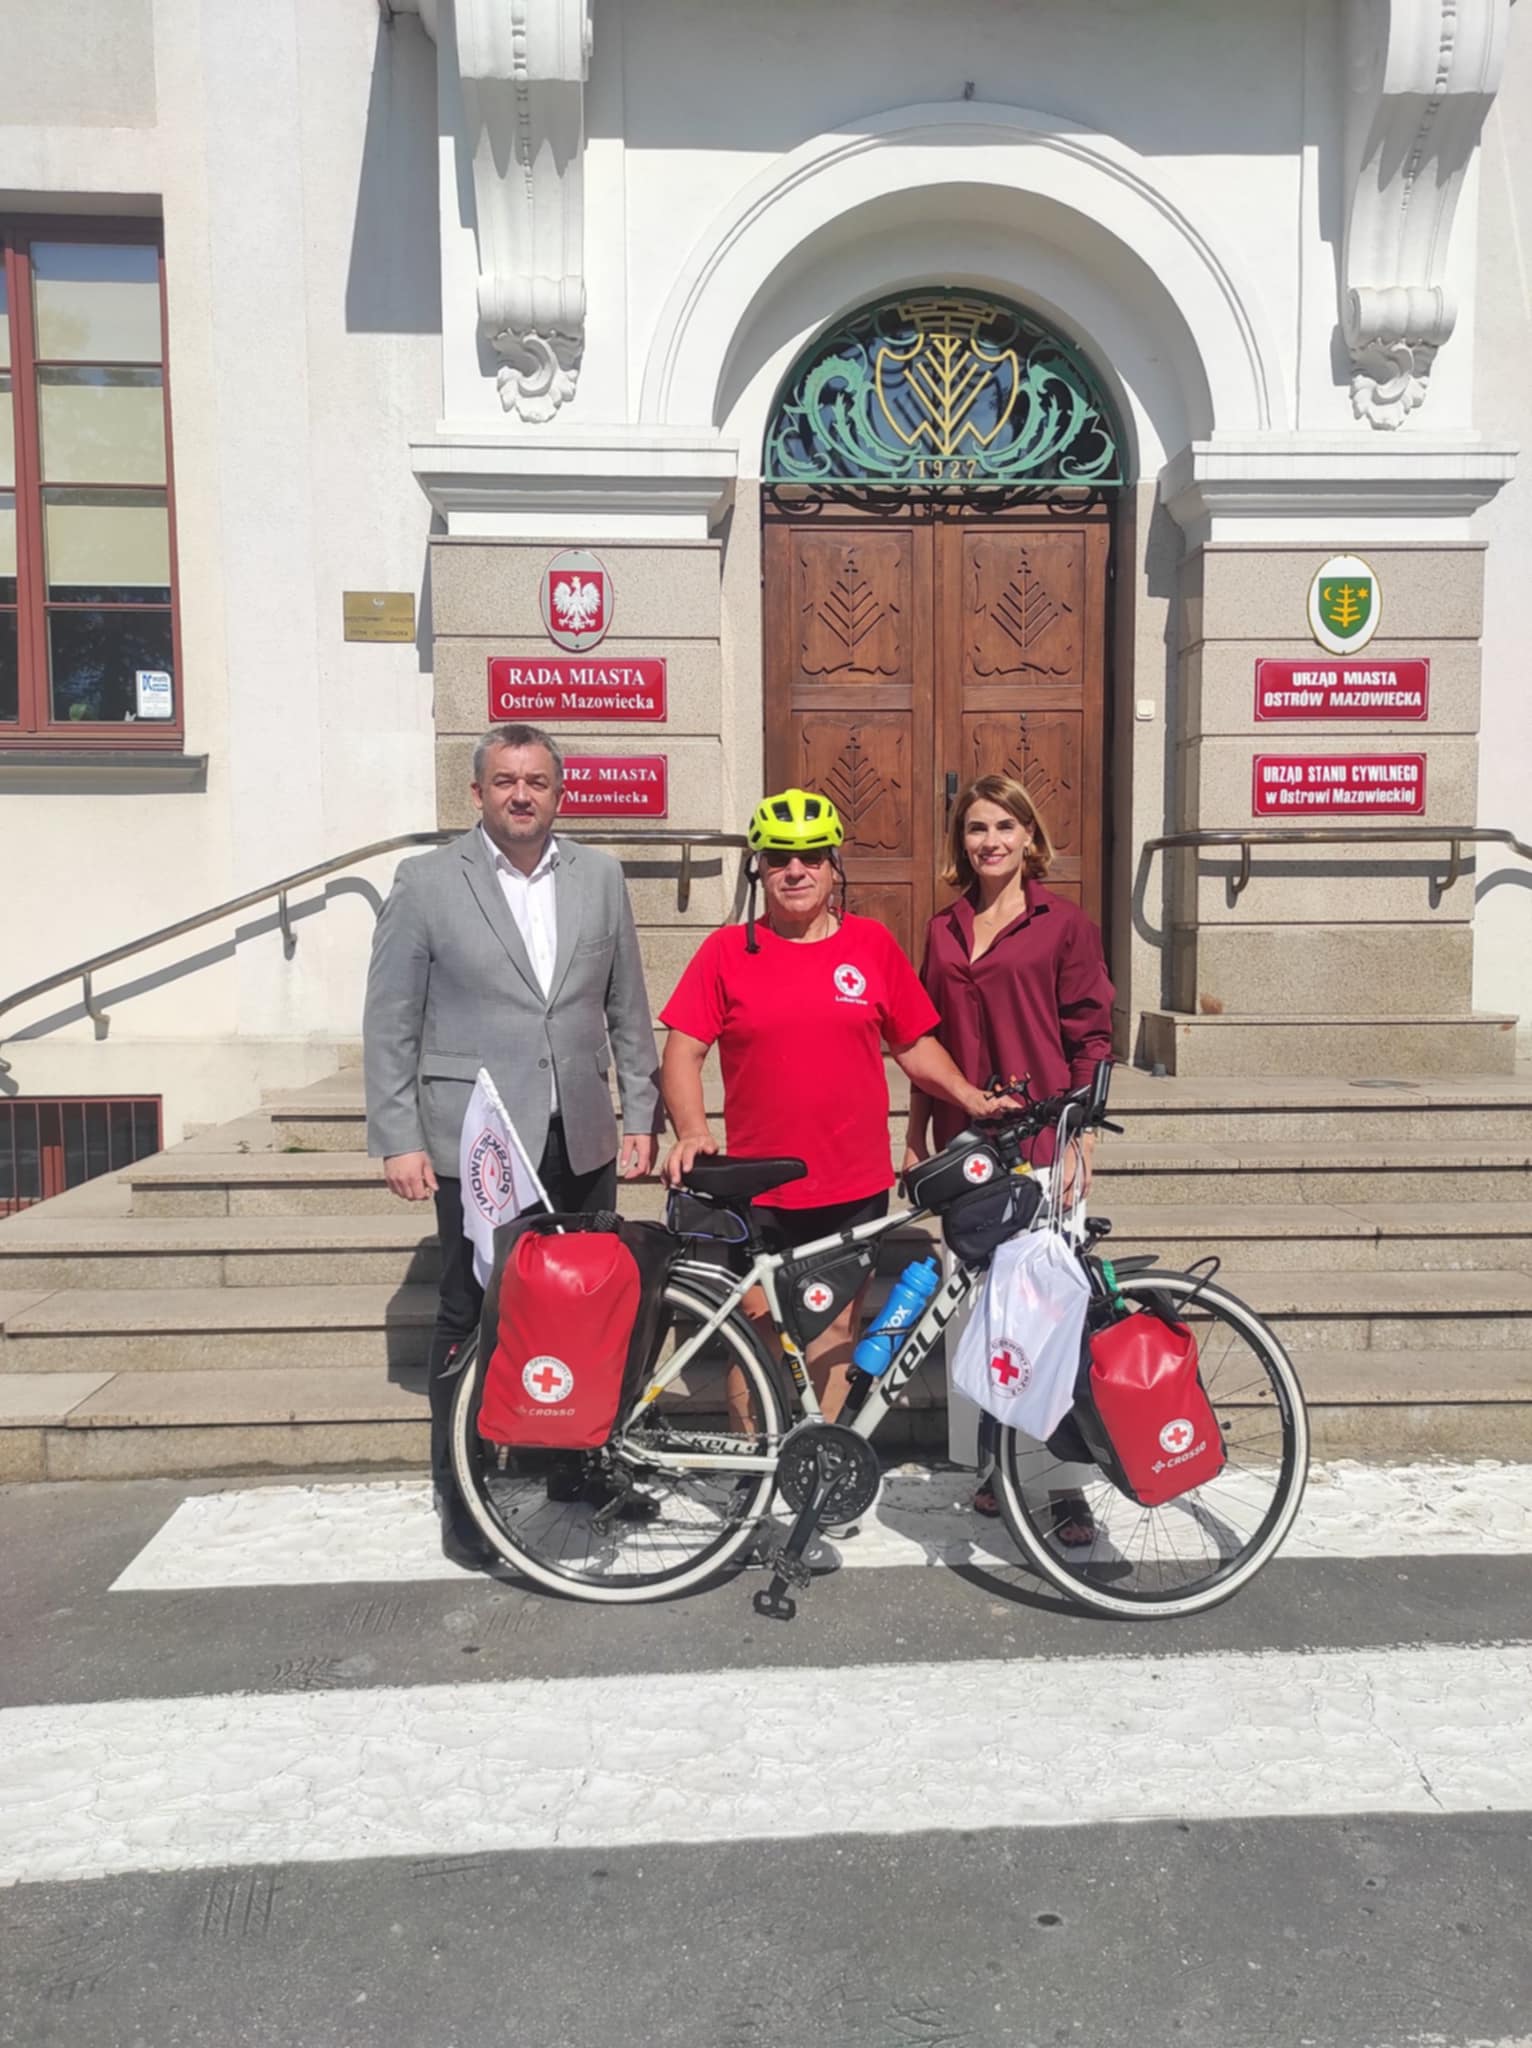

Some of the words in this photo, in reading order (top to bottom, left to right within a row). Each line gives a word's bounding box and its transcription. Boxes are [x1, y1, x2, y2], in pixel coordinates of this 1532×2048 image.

[918, 460, 977, 480] 1927
[509, 668, 563, 685] RADA
[569, 669, 645, 686] MIASTA
[1292, 672, 1337, 687] URZĄD
[1343, 671, 1397, 686] MIASTA
[501, 692, 556, 709] Ostrów
[561, 692, 655, 710] Mazowiecka
[1264, 689, 1323, 706] OSTRÓW
[1329, 692, 1422, 706] MAZOWIECKA
[599, 768, 657, 781] MIASTA
[1263, 765, 1302, 785] URZĄD
[1308, 765, 1347, 782] STANU
[1351, 765, 1418, 782] CYWILNEGO
[567, 790, 649, 803] Mazowiecka
[1265, 791, 1277, 804] w
[1280, 788, 1330, 804] Ostrowi
[1332, 787, 1416, 805] Mazowieckiej
[528, 1408, 576, 1416] CROSSO
[1166, 1440, 1207, 1469] CROSSO
